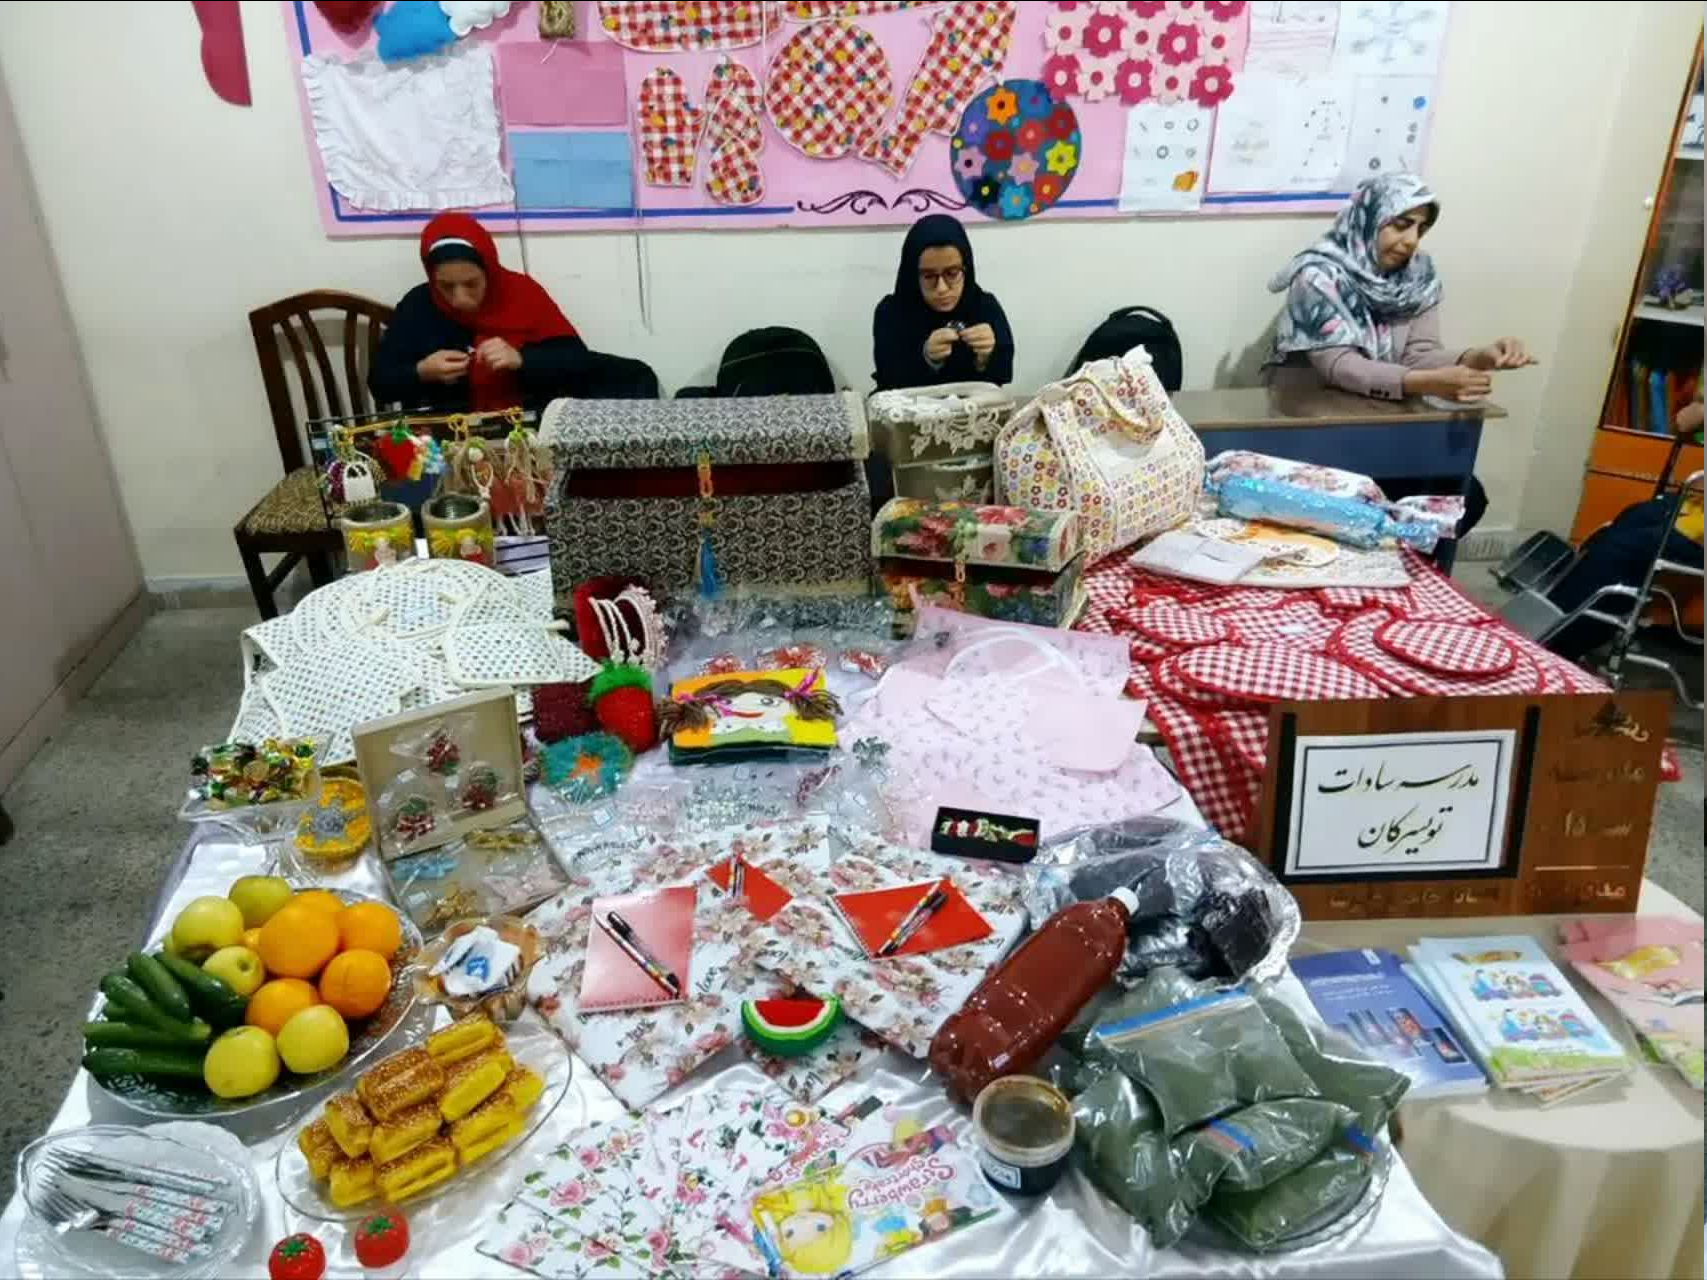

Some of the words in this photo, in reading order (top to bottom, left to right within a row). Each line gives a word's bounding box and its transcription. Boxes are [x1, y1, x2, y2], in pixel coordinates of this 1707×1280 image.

[1318, 761, 1395, 794] سادات
[1395, 764, 1479, 790] مدرسه
[1358, 802, 1454, 855] تویسرکان
